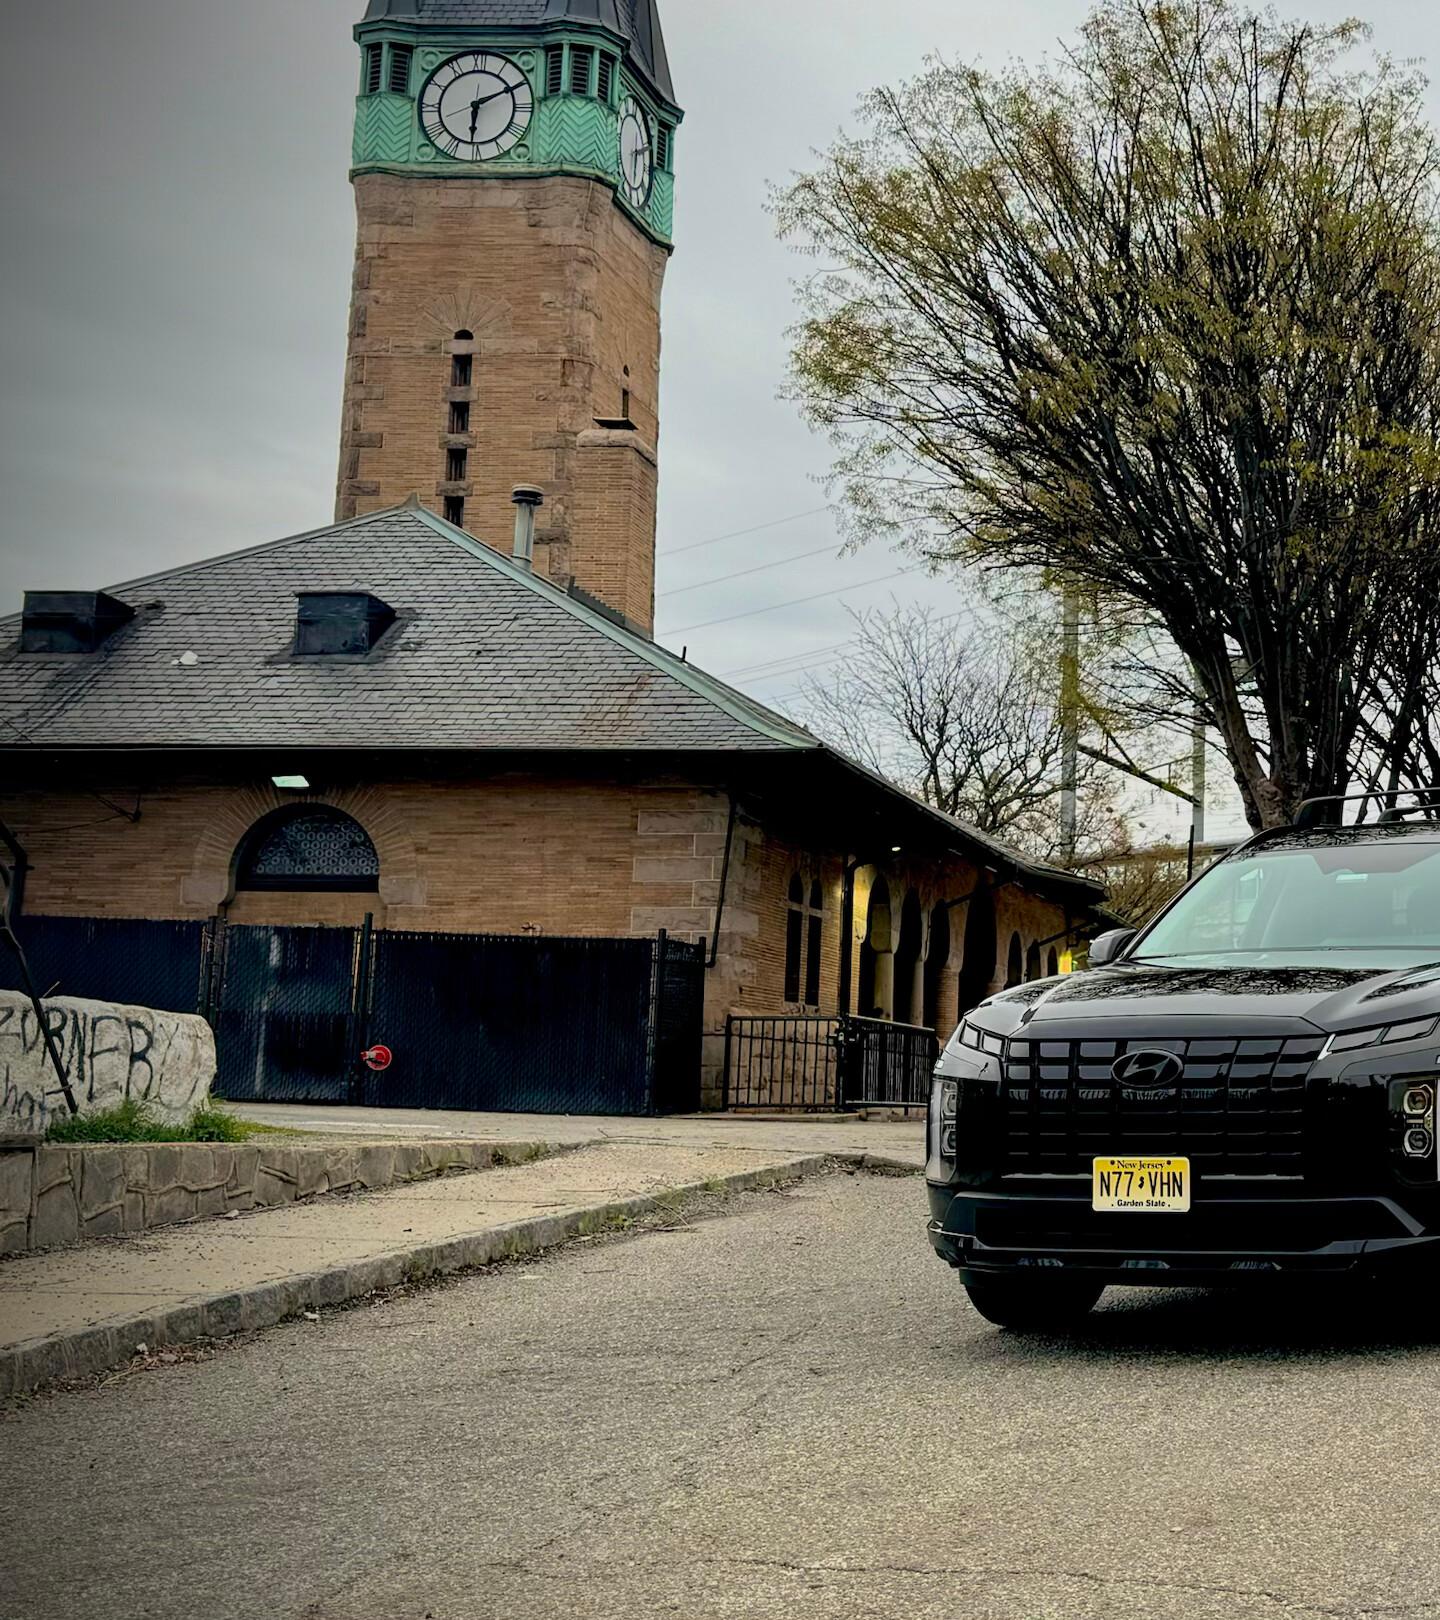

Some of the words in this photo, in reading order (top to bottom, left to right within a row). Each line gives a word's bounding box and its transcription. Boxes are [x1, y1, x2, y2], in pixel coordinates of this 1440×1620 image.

[1117, 1160, 1136, 1169] New
[1138, 1160, 1165, 1171] Jersey
[1100, 1171, 1134, 1197] N77
[1148, 1171, 1183, 1197] VHN
[1117, 1199, 1144, 1207] Garden
[1146, 1199, 1166, 1207] State
